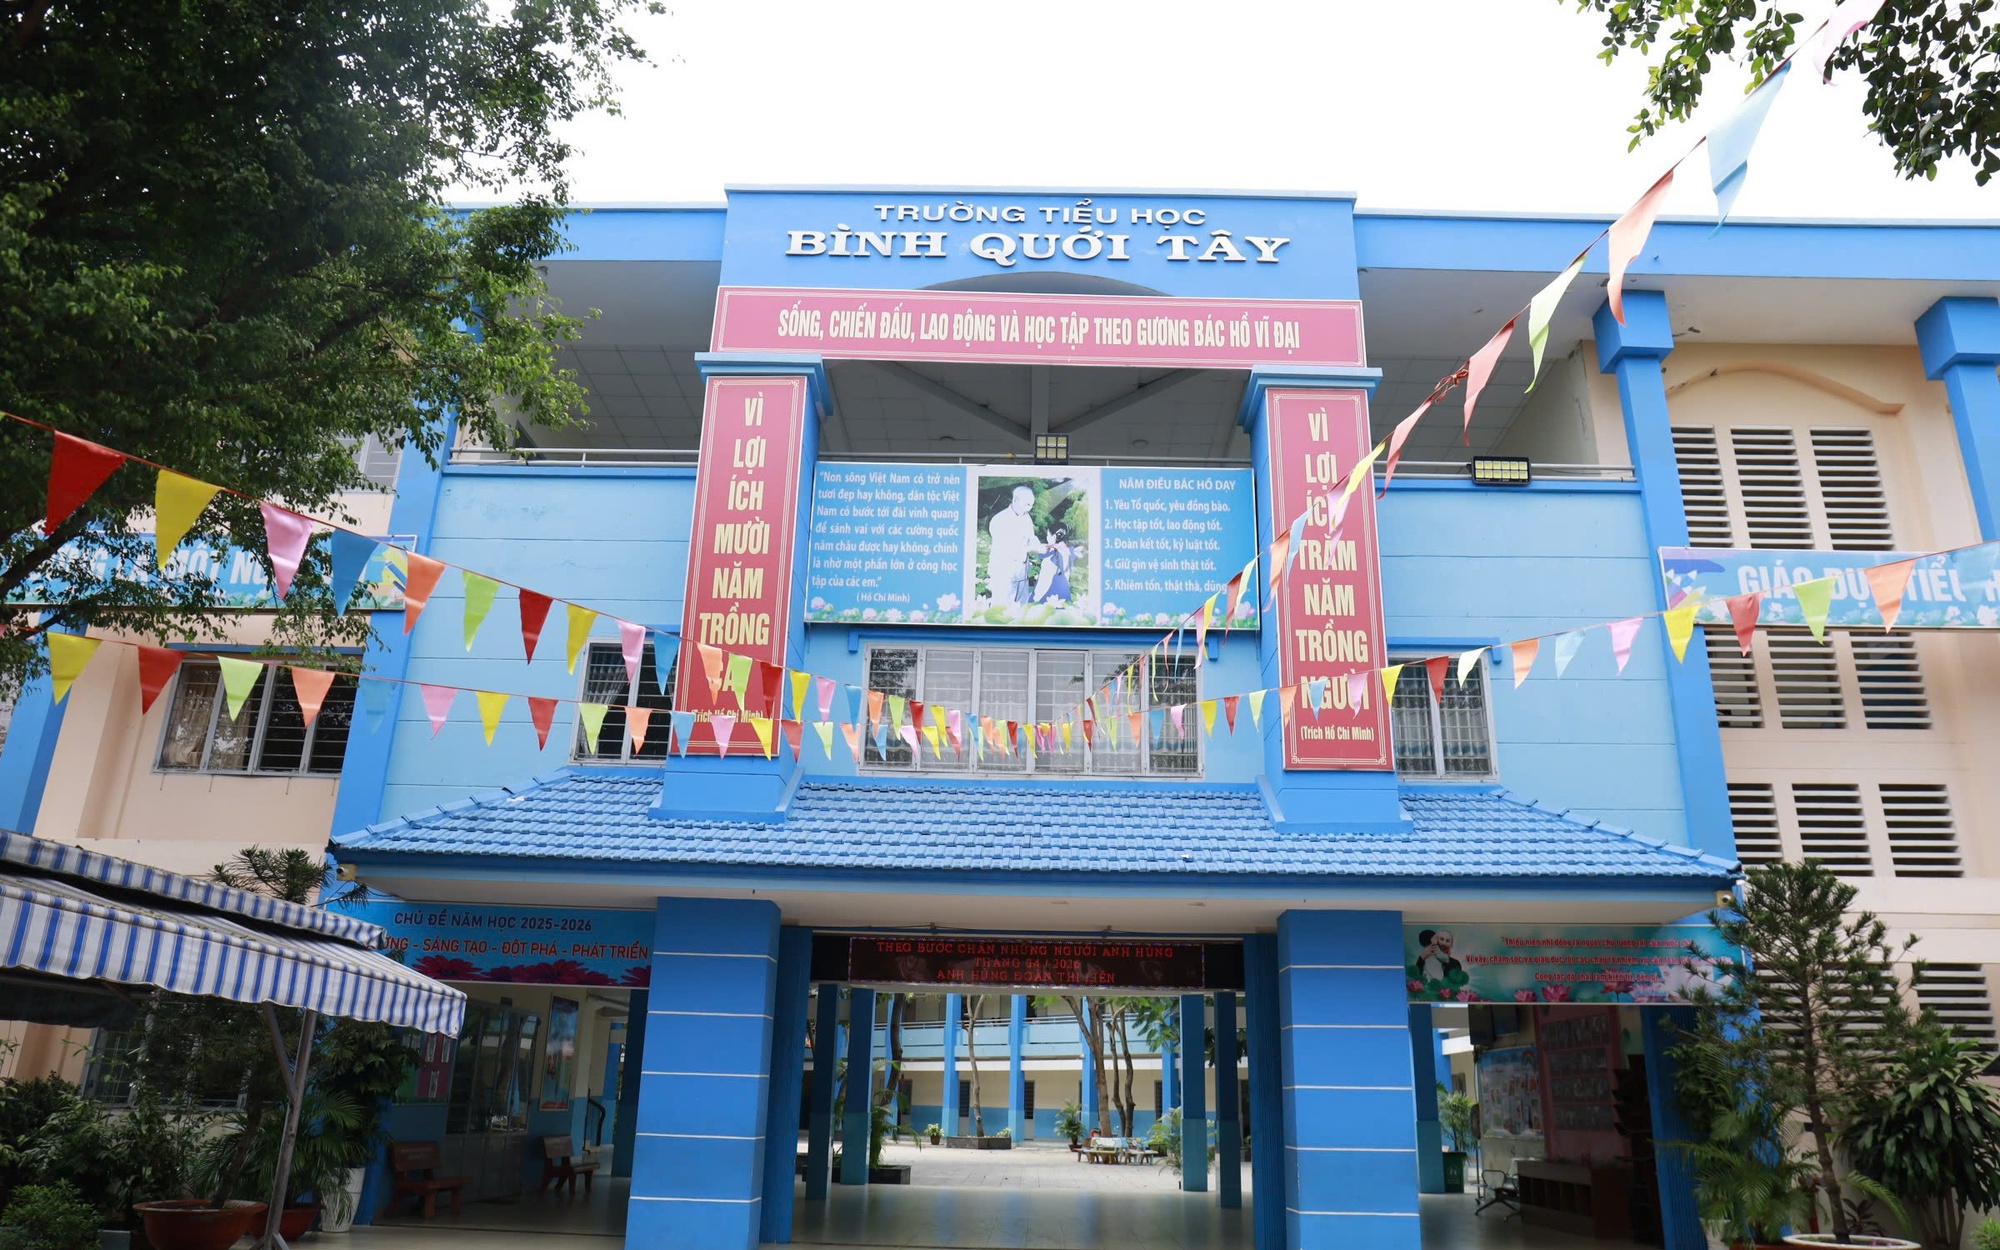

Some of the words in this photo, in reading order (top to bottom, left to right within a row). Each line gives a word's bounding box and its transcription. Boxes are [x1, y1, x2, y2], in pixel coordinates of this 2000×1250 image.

[874, 201, 1025, 222] TRƯỜNG
[1039, 198, 1117, 225] TIỂU
[1131, 209, 1206, 230] HỌC
[786, 223, 947, 257] BÌNH
[970, 226, 1130, 267] QUỚI
[1156, 229, 1290, 263] TÂY
[778, 301, 824, 340] SỐNG,
[829, 302, 876, 339] CHIẾN
[880, 302, 915, 343] ĐẤU,
[920, 312, 948, 341] LAO
[953, 309, 995, 347] ĐỘNG
[1000, 310, 1019, 342] VÀ
[1024, 315, 1055, 349] HỌC
[1061, 311, 1088, 349] TẬP
[1094, 318, 1132, 345] THEO
[1137, 316, 1189, 347] GƯƠNG
[1194, 313, 1225, 347] BÁC
[1230, 312, 1250, 348] HỒ
[1254, 316, 1270, 348] VĨ
[1274, 321, 1300, 355] ĐẠI
[745, 392, 763, 426] VÌ
[1308, 407, 1328, 441] VÌ
[733, 436, 766, 474] LỢI
[845, 473, 866, 485] sông
[869, 473, 886, 486] Việt
[890, 474, 910, 483] Nam
[914, 474, 923, 483] có
[944, 475, 960, 484] nên
[1305, 451, 1337, 490] LỢI
[728, 474, 764, 510] ÍCH
[819, 490, 835, 499] tươi
[838, 489, 854, 501] đẹp
[857, 490, 872, 502] hay
[875, 489, 905, 503] không,
[908, 490, 924, 500] dân
[927, 491, 940, 504] tộc
[942, 491, 960, 505] Việt
[1174, 478, 1194, 490] BÁC
[1216, 480, 1235, 493] DẠY
[817, 506, 836, 516] Nam
[840, 506, 849, 517] có
[853, 506, 874, 517] bước
[878, 507, 889, 517] tới
[892, 507, 905, 518] đài
[909, 508, 928, 518] vinh
[931, 510, 959, 521] quang
[1105, 500, 1113, 510] 1.
[1114, 500, 1129, 510] Yêu
[1144, 499, 1167, 513] quốc,
[1169, 501, 1185, 513] yêu
[1212, 500, 1230, 512] bào.
[1307, 490, 1328, 527] ÍC
[714, 516, 770, 554] MƯỜI
[830, 523, 850, 533] sánh
[855, 525, 867, 534] vai
[871, 524, 884, 534] với
[888, 525, 902, 535] các
[906, 525, 933, 538] cường
[937, 524, 959, 537] quốc
[1105, 519, 1112, 529] 2.
[1115, 519, 1131, 532] Học
[1133, 519, 1147, 532] tập
[1150, 518, 1165, 531] tốt,
[1167, 521, 1180, 530] lao
[1183, 520, 1205, 533] động
[1207, 519, 1222, 531] tốt.
[815, 540, 833, 550] năm
[835, 540, 856, 550] châu
[859, 541, 880, 553] được
[883, 541, 898, 554] hay
[901, 541, 931, 555] không,
[934, 542, 957, 553] chính
[1105, 538, 1113, 549] 3.
[1115, 538, 1138, 549] Đoàn
[1140, 537, 1154, 549] kết
[1156, 537, 1171, 551] tốt,
[1186, 539, 1203, 553] luật
[1205, 538, 1220, 550] tốt.
[1299, 533, 1358, 571] TRĂM
[813, 557, 820, 568] là
[824, 558, 842, 568] nhờ
[844, 559, 862, 572] một
[890, 559, 904, 570] lớn
[917, 561, 938, 573] công
[941, 560, 957, 574] học
[1105, 559, 1113, 569] 4.
[1115, 558, 1130, 569] Giữ
[1148, 560, 1158, 572] vệ
[1160, 560, 1178, 570] sinh
[1181, 559, 1199, 573] thật
[1201, 558, 1216, 571] tốt.
[712, 561, 763, 599] NĂM
[812, 576, 826, 589] tập
[829, 574, 843, 586] của
[846, 576, 859, 586] các
[1105, 580, 1113, 590] 5.
[1115, 579, 1143, 590] Khiêm
[1145, 579, 1162, 592] tốn,
[1165, 580, 1183, 594] thật
[1824, 567, 1870, 608] DỤ
[1303, 578, 1355, 616] NĂM
[700, 602, 770, 645] TRỒNG
[1296, 619, 1369, 663] TRỒNG
[1301, 725, 1322, 740] (Trích
[1352, 727, 1374, 742] Minh)
[394, 910, 422, 925] CHỦ
[451, 911, 482, 927] NĂM
[487, 915, 516, 931] HỌC
[520, 917, 592, 931] 2025-2026
[422, 936, 459, 952] SÁNG
[463, 940, 488, 956] TẠO
[502, 939, 528, 958] ĐỘT
[530, 940, 558, 956] PHÁ
[572, 941, 607, 957] PHÁT
